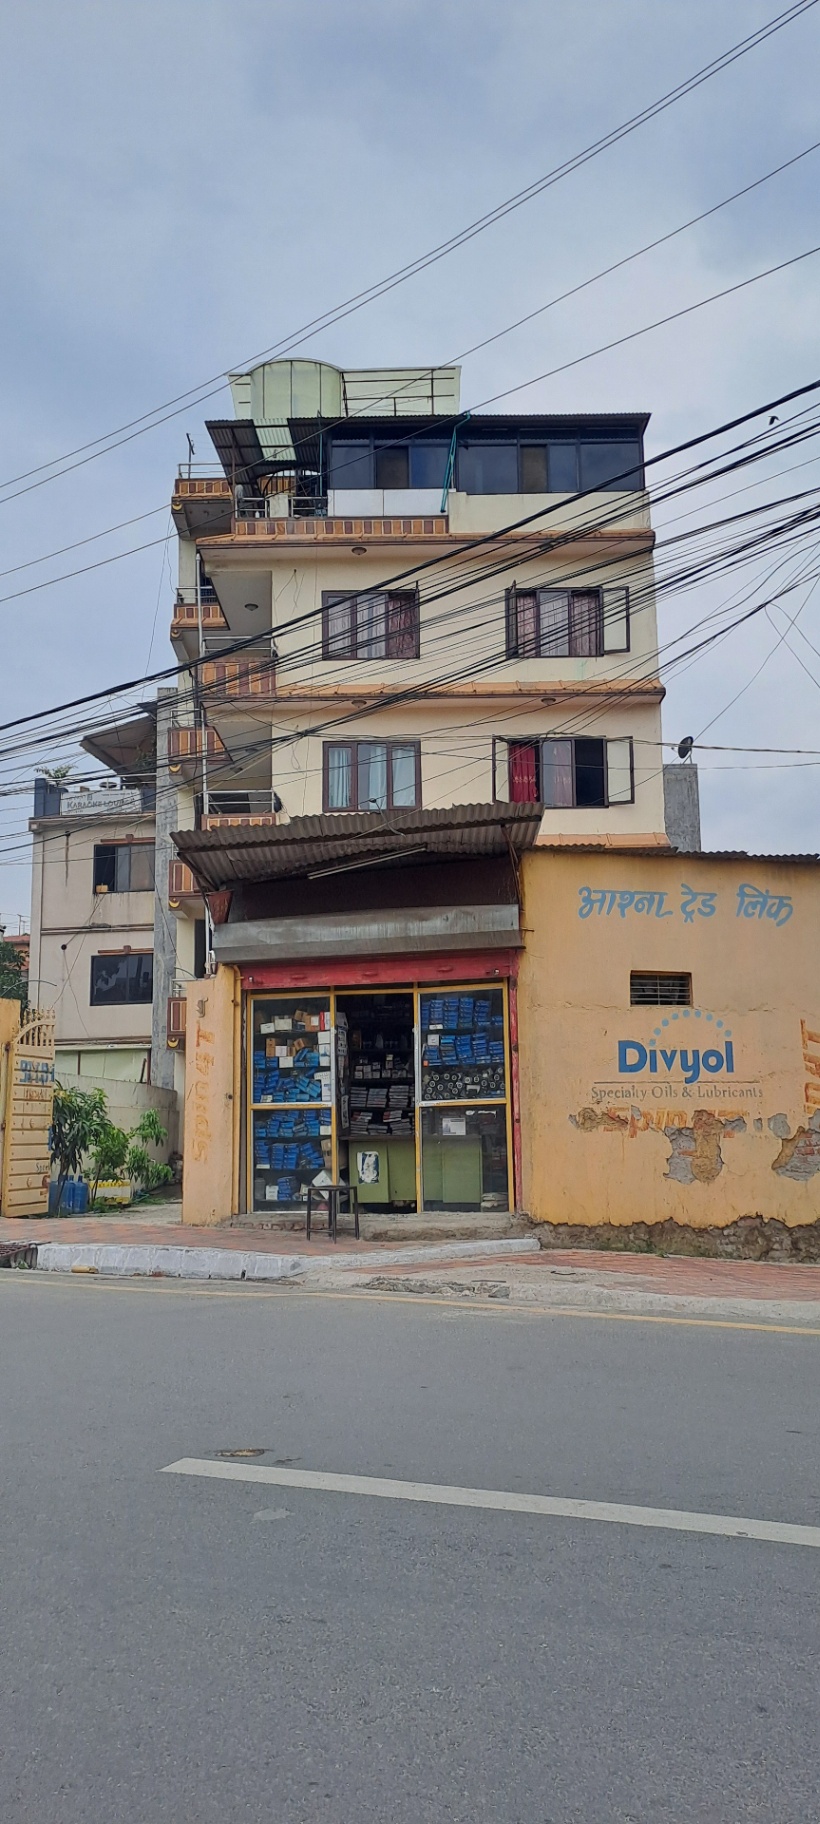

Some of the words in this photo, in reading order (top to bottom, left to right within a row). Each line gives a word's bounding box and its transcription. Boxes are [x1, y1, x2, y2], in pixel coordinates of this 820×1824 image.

[680, 883, 717, 923] ट्रेड
[736, 883, 794, 927] लिंक
[617, 1039, 734, 1085] Divyol
[591, 1085, 647, 1101] Specialty
[651, 1086, 678, 1098] Oils
[681, 1086, 693, 1098] &
[697, 1086, 764, 1098] Lubricants
